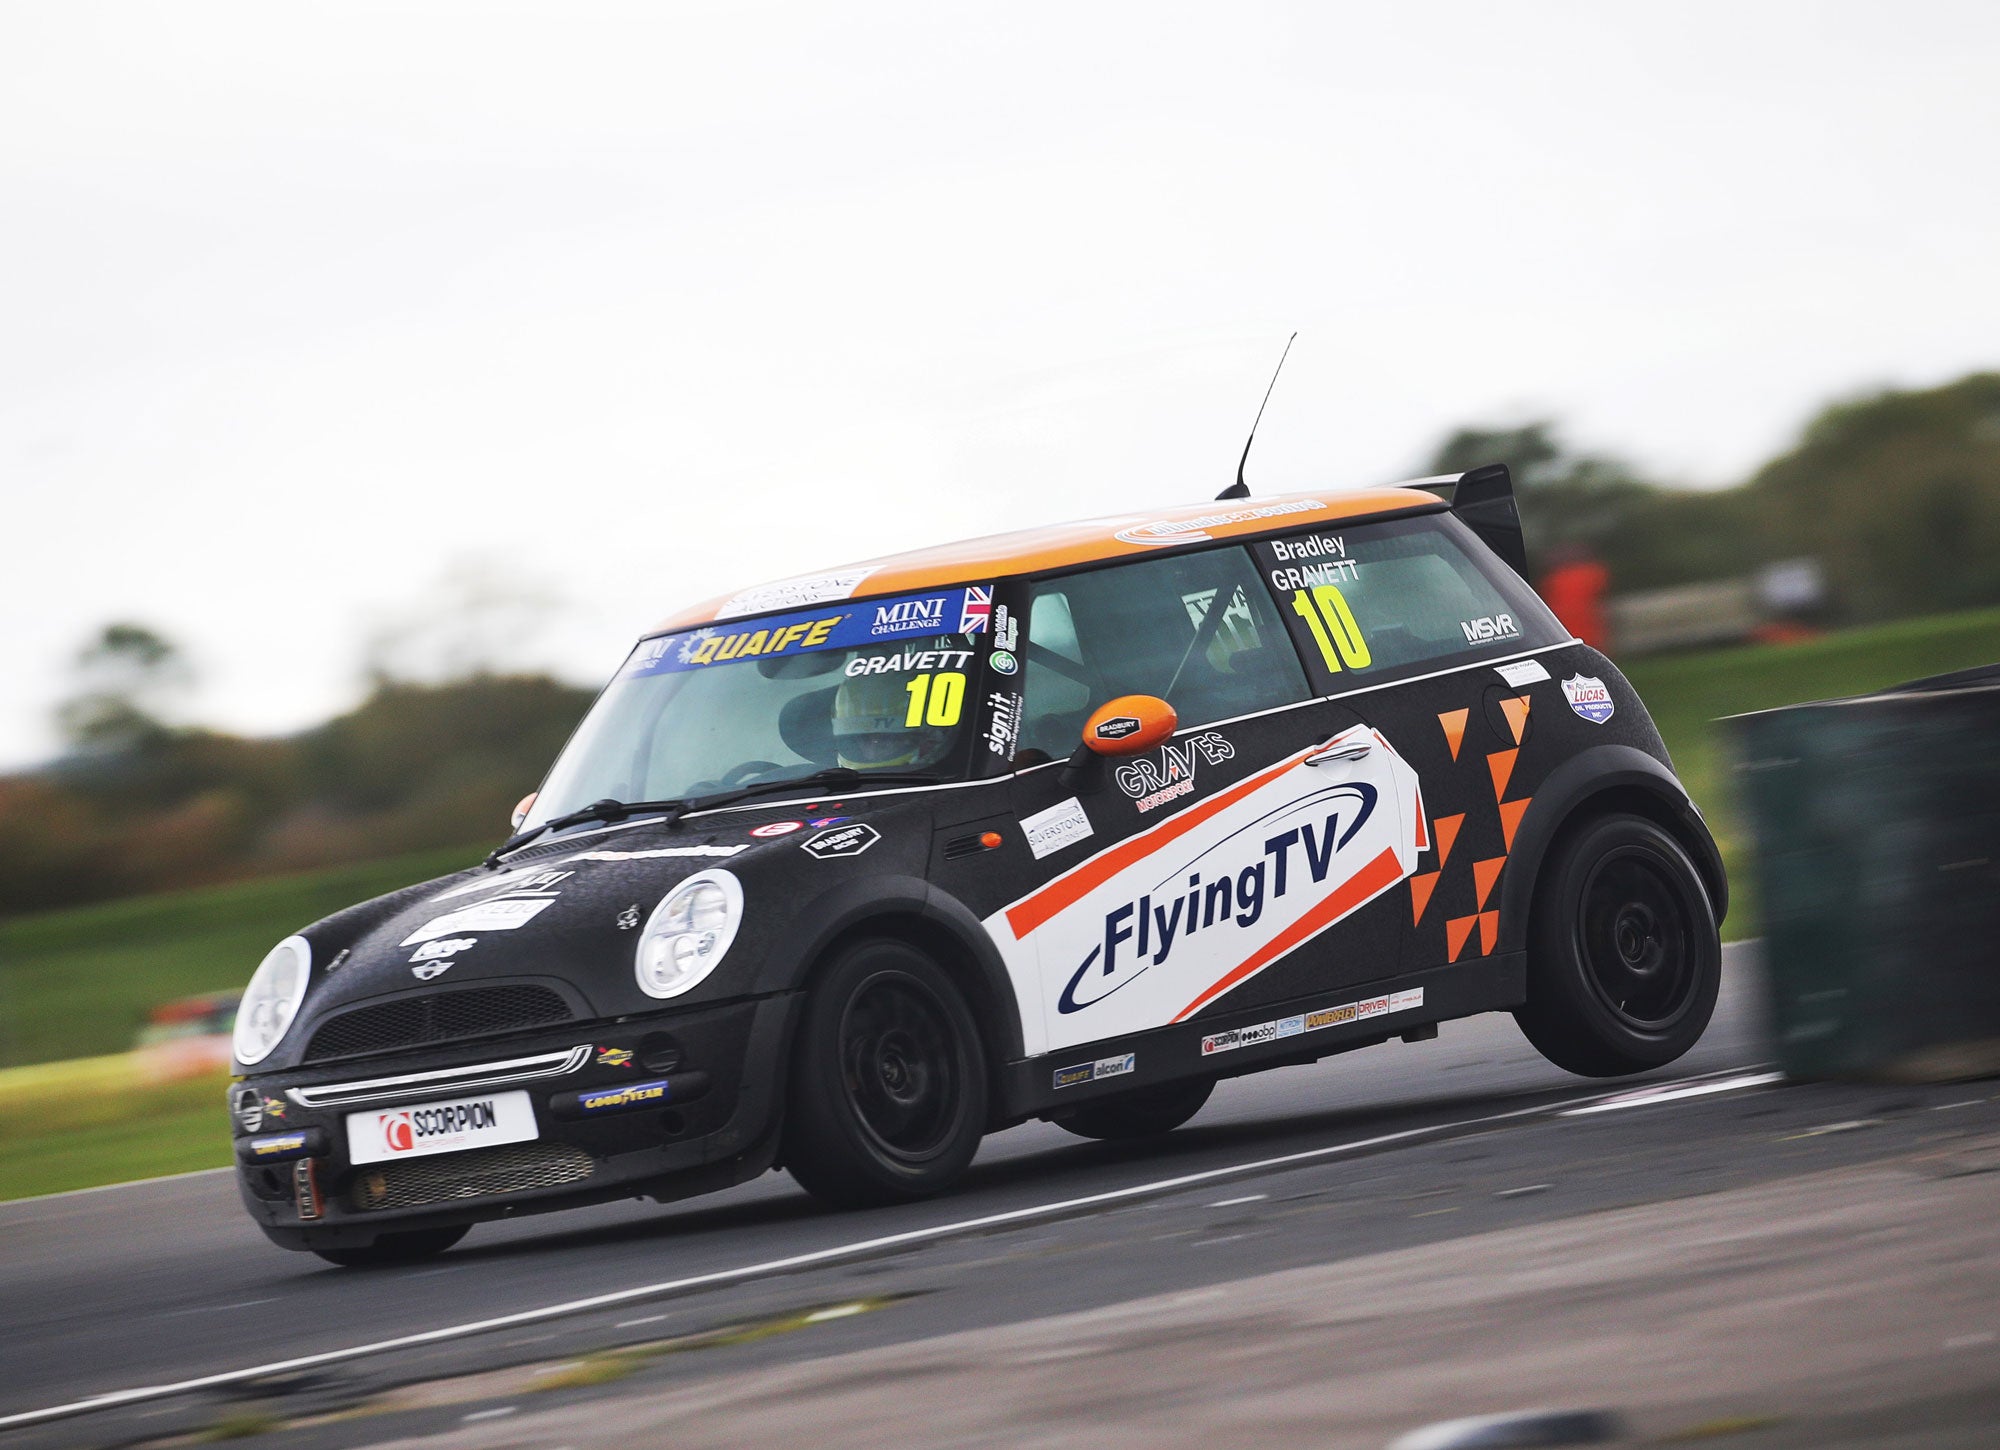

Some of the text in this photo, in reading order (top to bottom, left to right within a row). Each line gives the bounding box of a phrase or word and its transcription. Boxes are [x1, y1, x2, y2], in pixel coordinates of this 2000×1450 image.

[1271, 535, 1346, 561] Bradley
[1271, 559, 1359, 591] GRAVETT
[872, 598, 947, 626] MINI
[690, 615, 844, 666] QUAIFE
[871, 619, 942, 636] CHALLENGE
[1292, 585, 1372, 673] 10
[1460, 613, 1518, 641] MSVR
[844, 650, 976, 677] GRAVETT
[905, 672, 967, 728] 10
[1574, 689, 1605, 702] LUCAS
[1099, 721, 1136, 733] BRADBURY
[1115, 731, 1236, 798] GRAVES
[1135, 779, 1195, 813] MOTORSPORT
[810, 827, 865, 850] BRADBURY
[1028, 813, 1086, 846] SILVERSTONE
[1103, 812, 1340, 977] FlyingTV
[1306, 1006, 1356, 1028] POWERFLEX
[1358, 998, 1388, 1015] DRIVEN
[1095, 1062, 1124, 1077] alcon
[413, 1100, 497, 1138] SCORPION
